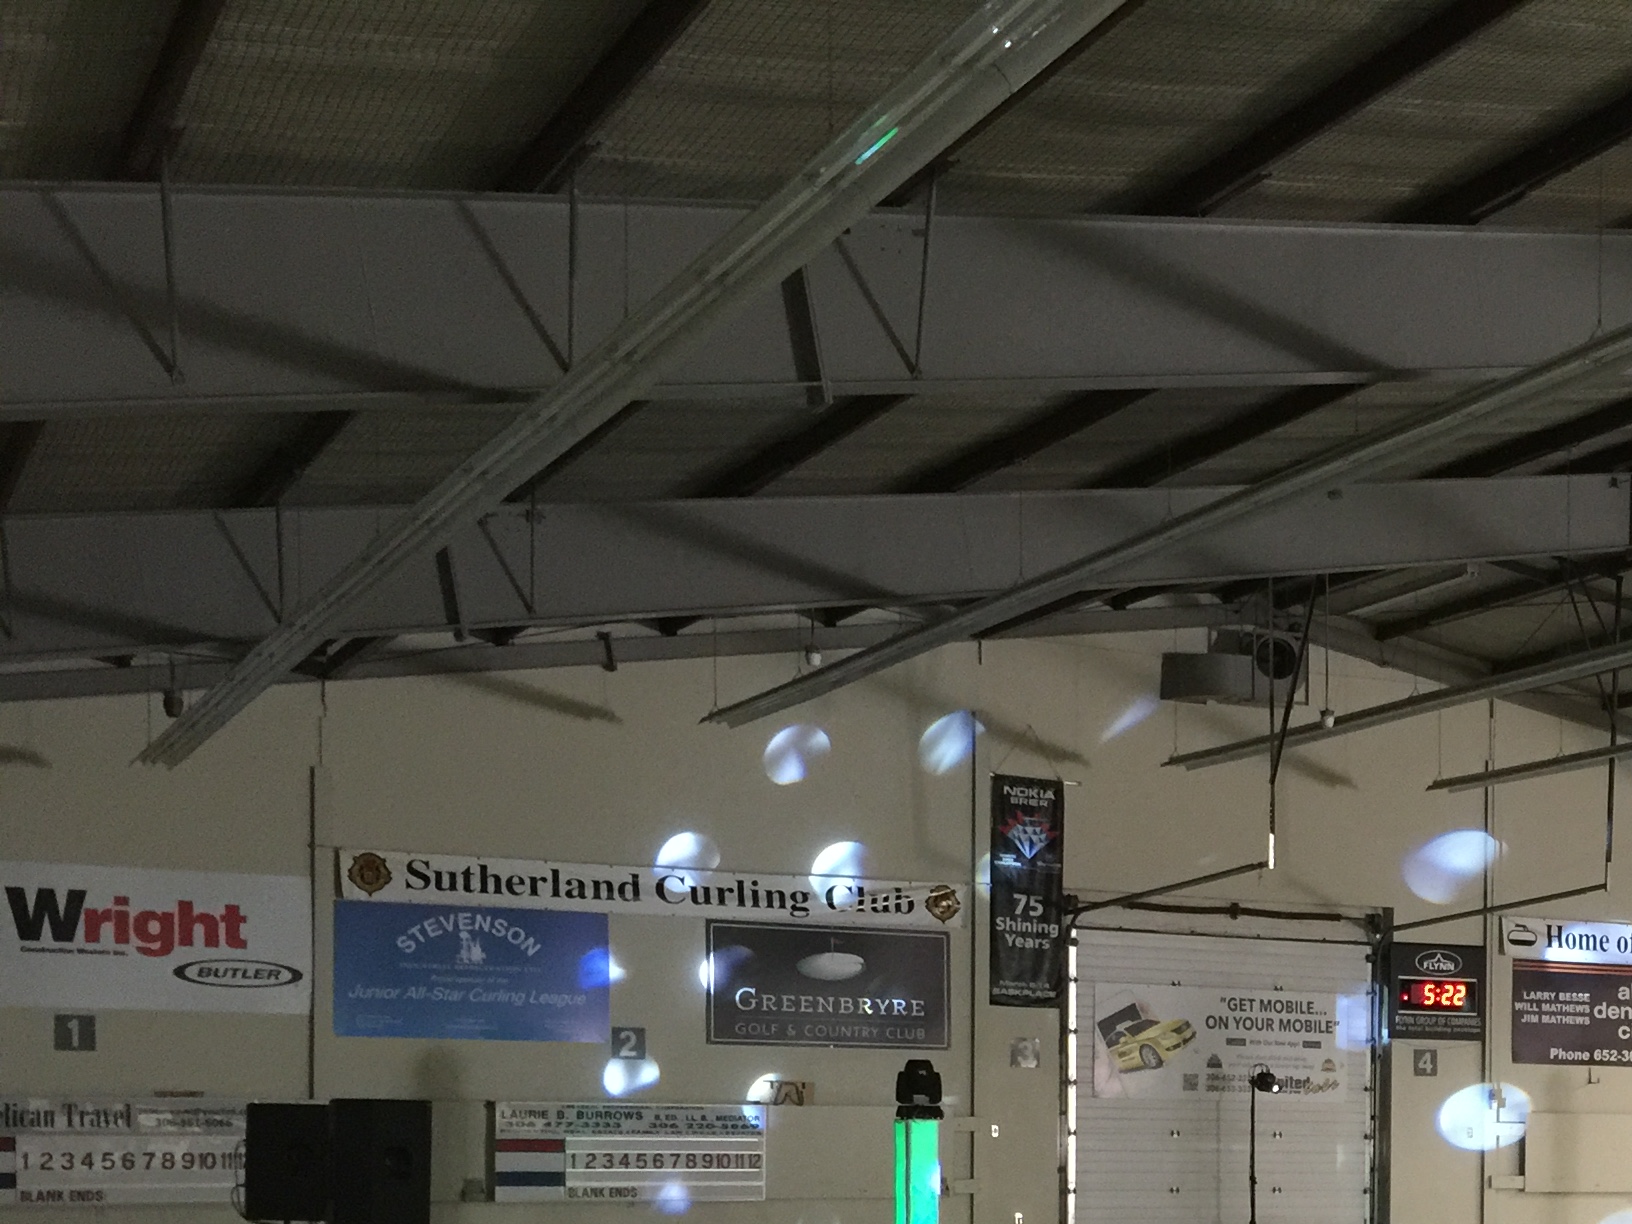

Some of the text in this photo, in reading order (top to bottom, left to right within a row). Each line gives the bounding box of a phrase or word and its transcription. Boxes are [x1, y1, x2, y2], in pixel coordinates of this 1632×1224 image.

[1003, 785, 1056, 800] NOKIA
[404, 858, 916, 917] Sutherland Curling Club
[1013, 893, 1044, 917] 75
[4, 886, 248, 957] Wright
[995, 916, 1059, 938] Shining
[395, 912, 542, 957] STEVENSON
[1004, 933, 1050, 949] Years
[1546, 925, 1610, 952] Home
[197, 966, 281, 981] BUTLER
[1423, 961, 1455, 971] FLYNN
[348, 984, 587, 1007] Junior All-Star Curling League
[734, 987, 926, 1016] GREENBRYRE
[1423, 983, 1467, 1006] 5:22
[1523, 991, 1556, 1000] LARRY
[1514, 1002, 1590, 1014] WILL MATHEWS
[1205, 1015, 1229, 1030] ON
[1233, 1016, 1275, 1032] YOUR
[1520, 1014, 1590, 1025] JIM MATHEWS
[66, 1019, 79, 1048] 1
[735, 1022, 926, 1040] GOLF & COUNTRY CLUB
[619, 1030, 637, 1056] 2
[1016, 1040, 1037, 1067] 3
[1418, 1051, 1433, 1074] 4
[1550, 1048, 1590, 1061] Phone
[62, 1103, 131, 1128] Travel
[501, 1109, 549, 1120] LAURIE
[576, 1110, 643, 1121] BURROWS
[21, 1152, 29, 1170] 1
[40, 1152, 54, 1170] 2
[61, 1152, 75, 1170] 3
[81, 1152, 95, 1170] 4
[101, 1152, 116, 1170] 5
[121, 1152, 136, 1170] 6
[142, 1152, 156, 1170] 7
[162, 1152, 176, 1170] 8
[181, 1152, 195, 1170] 9
[199, 1152, 217, 1170] 10
[221, 1152, 233, 1170] 11
[570, 1153, 761, 1169] 1 2 3 4 5 6 7 8 9 10 11 12
[20, 1189, 104, 1202] BLANK ENDS
[568, 1186, 638, 1198] BLANK ENDS
